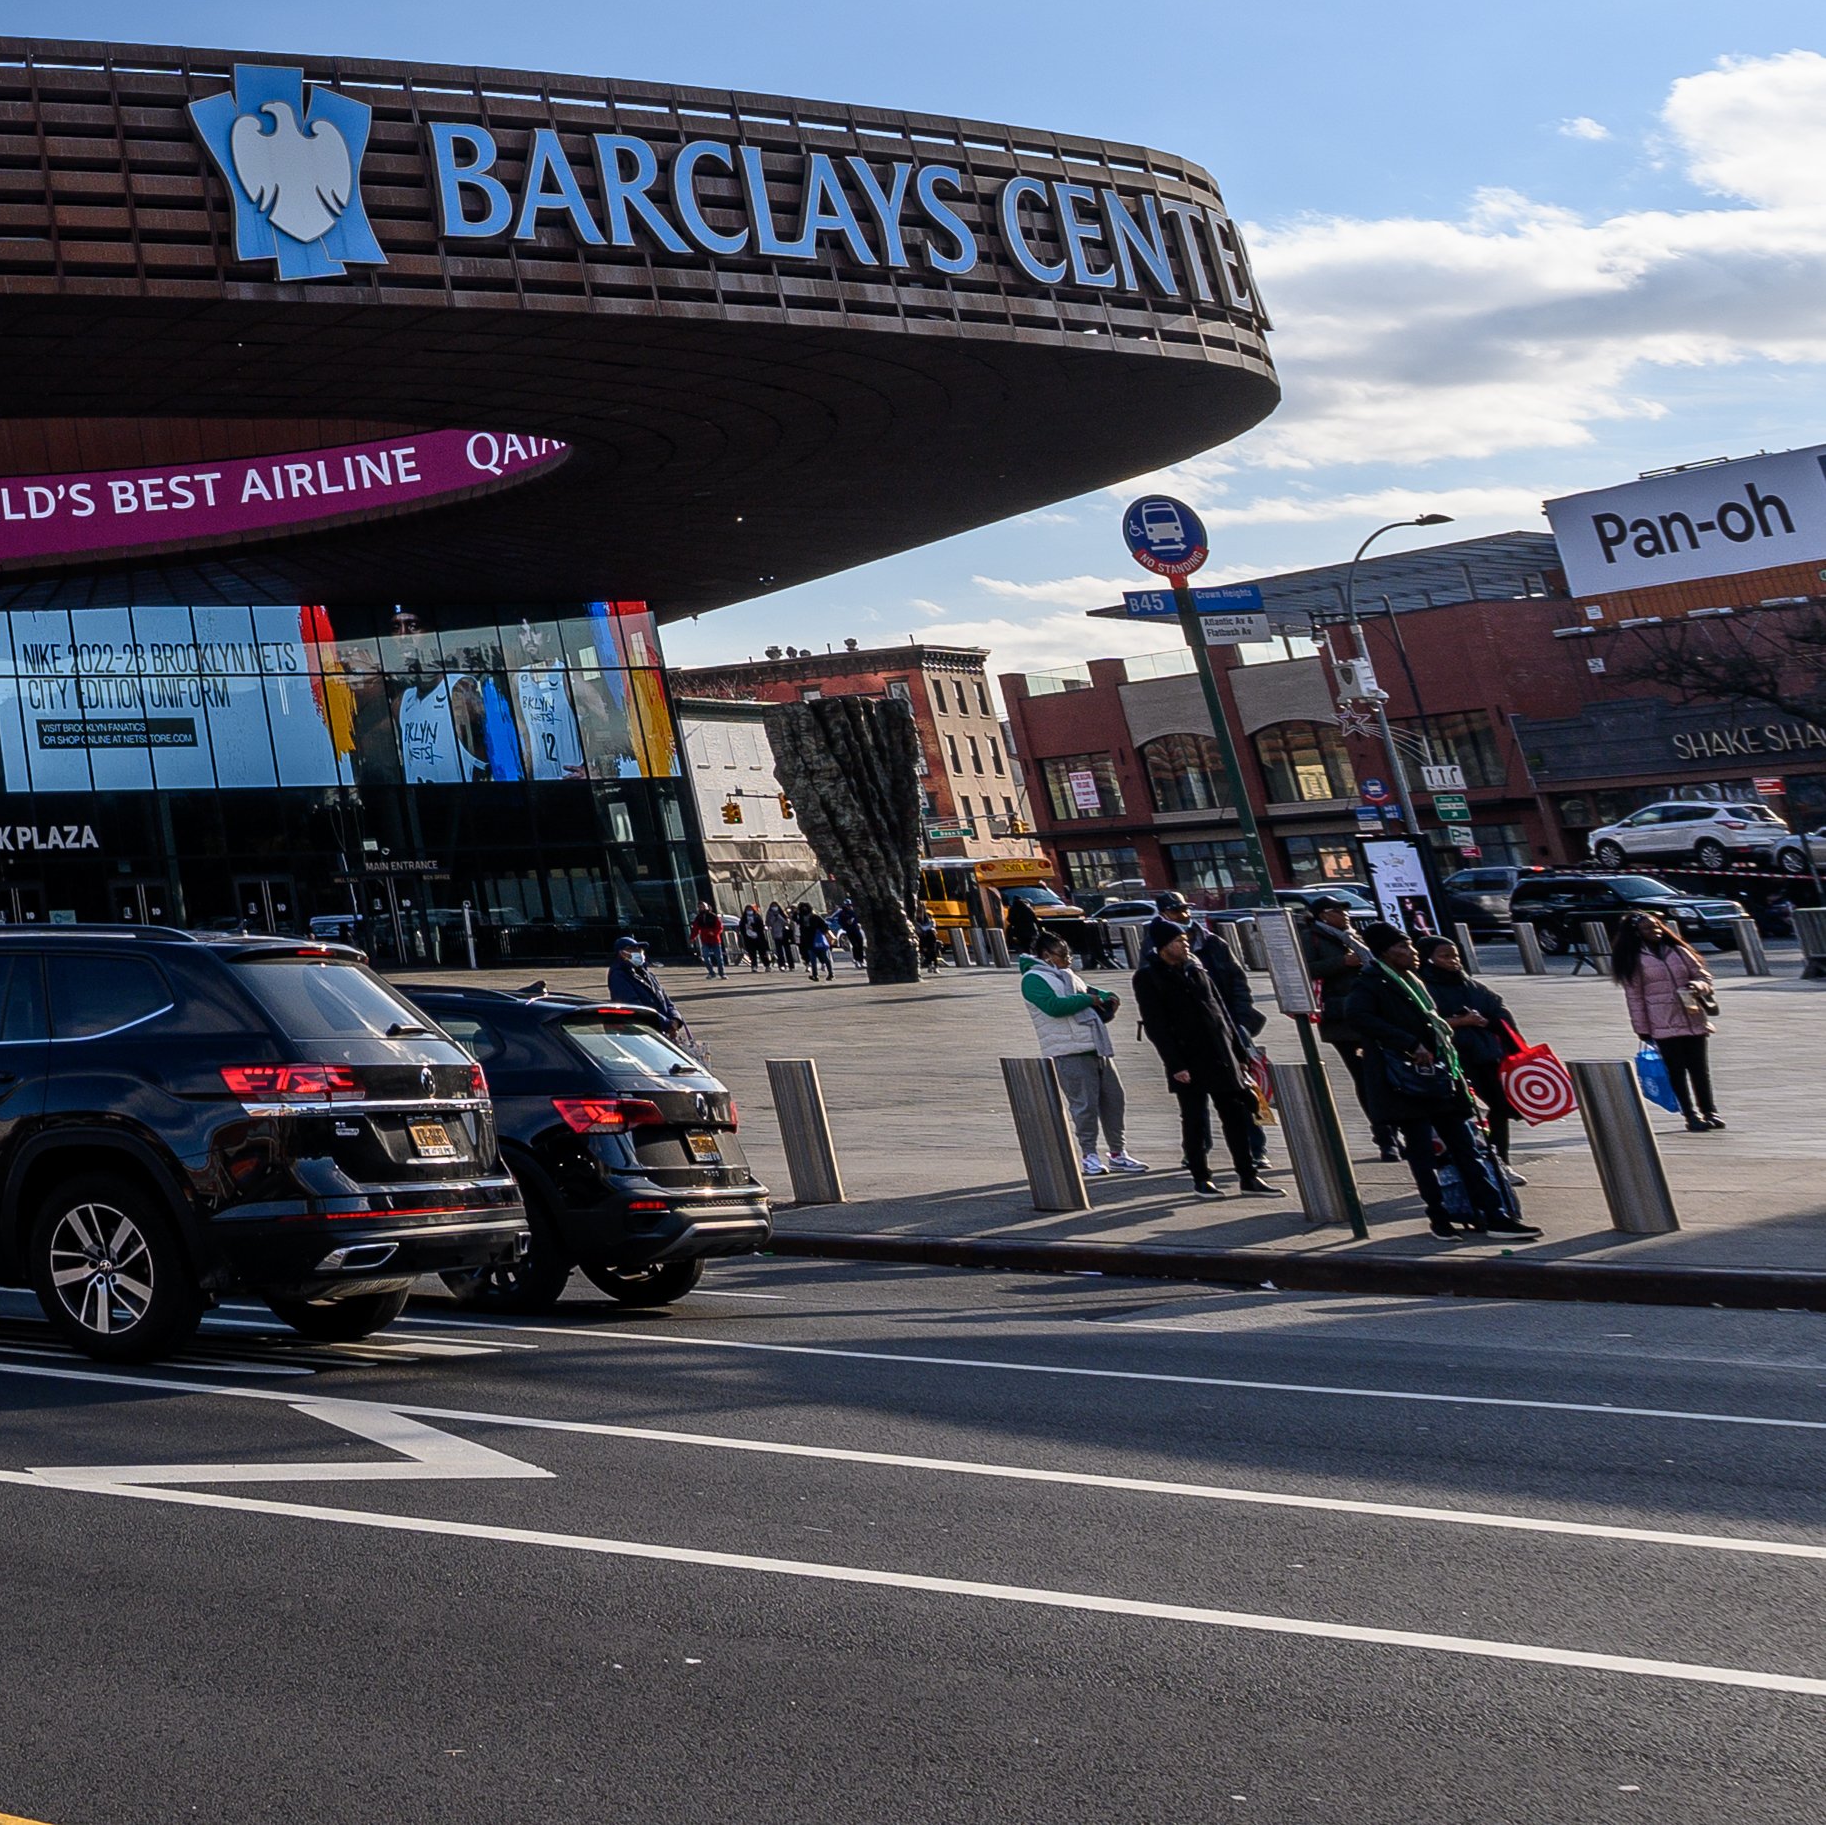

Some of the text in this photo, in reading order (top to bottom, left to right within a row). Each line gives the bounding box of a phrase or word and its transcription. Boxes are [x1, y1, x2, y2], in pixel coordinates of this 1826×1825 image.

[425, 121, 978, 275] BARCLAYS
[108, 473, 221, 515] BEST
[241, 447, 421, 504] AIRLINE
[1591, 482, 1796, 564] Pan-oh
[1139, 550, 1204, 574] NO STANDING
[1129, 593, 1164, 612] B45
[1196, 589, 1252, 599] Crown Heights
[1204, 617, 1234, 626] Atlantic
[23, 642, 297, 674] NIKE 2022-23 BROOKLYN NETS
[28, 678, 231, 709] CITY EDITION UNIFORM
[522, 695, 555, 712] BKLYN
[42, 724, 61, 732] VISIT
[107, 723, 146, 732] FANATICS
[43, 736, 56, 744] OR
[57, 735, 80, 744] SHOP
[112, 735, 122, 743] AT
[541, 732, 557, 761] 12
[1672, 722, 1826, 760] SHAKE SHA
[16, 825, 99, 850] PLAZA
[365, 860, 438, 871] MAIN ENTRANCE
